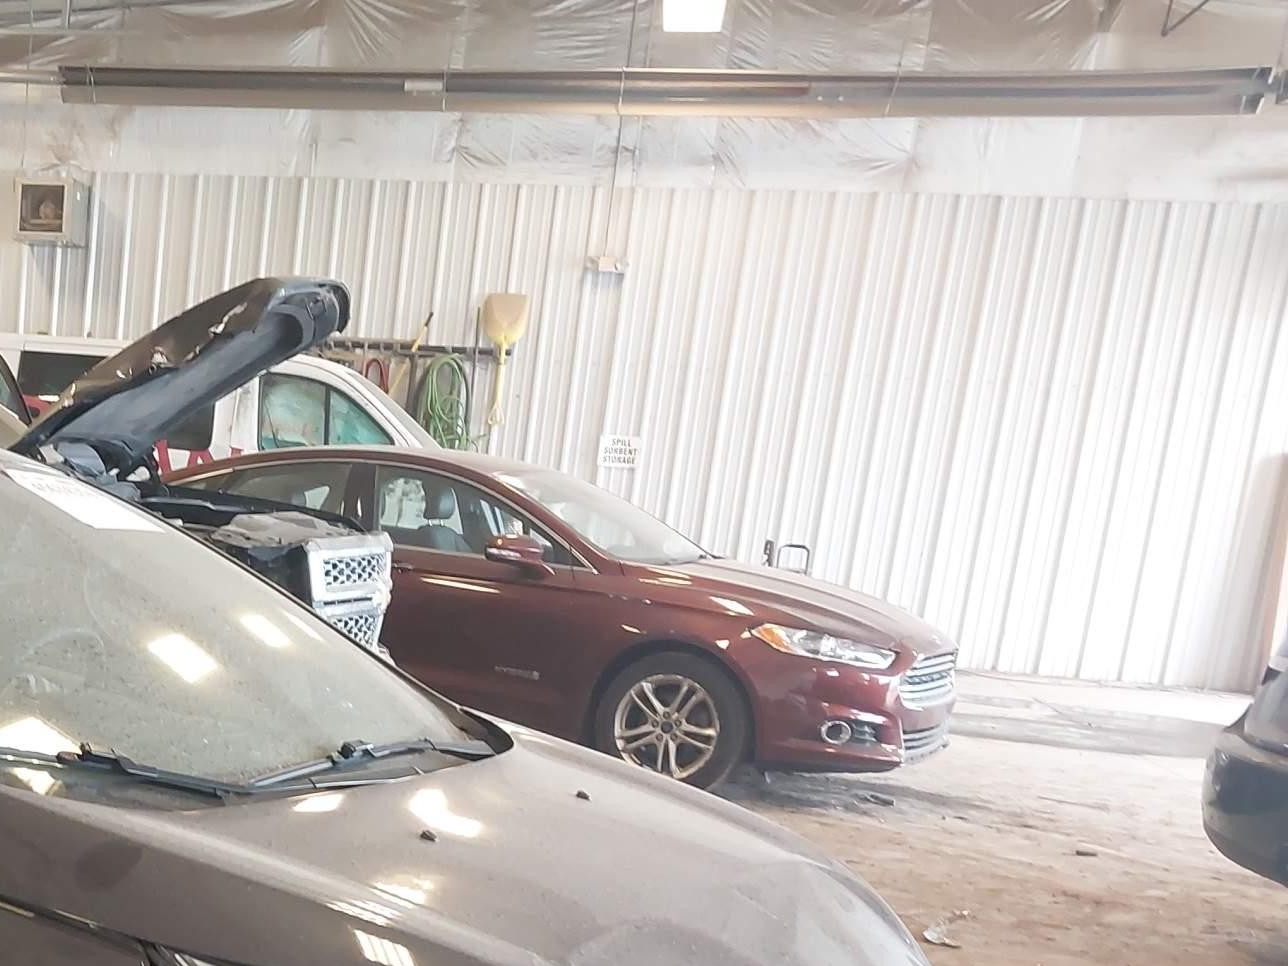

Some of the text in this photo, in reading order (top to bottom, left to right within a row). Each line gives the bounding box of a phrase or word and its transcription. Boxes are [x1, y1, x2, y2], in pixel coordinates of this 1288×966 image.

[611, 438, 631, 448] SPILL
[603, 446, 638, 456] SORBENT
[602, 455, 636, 465] STORAGE
